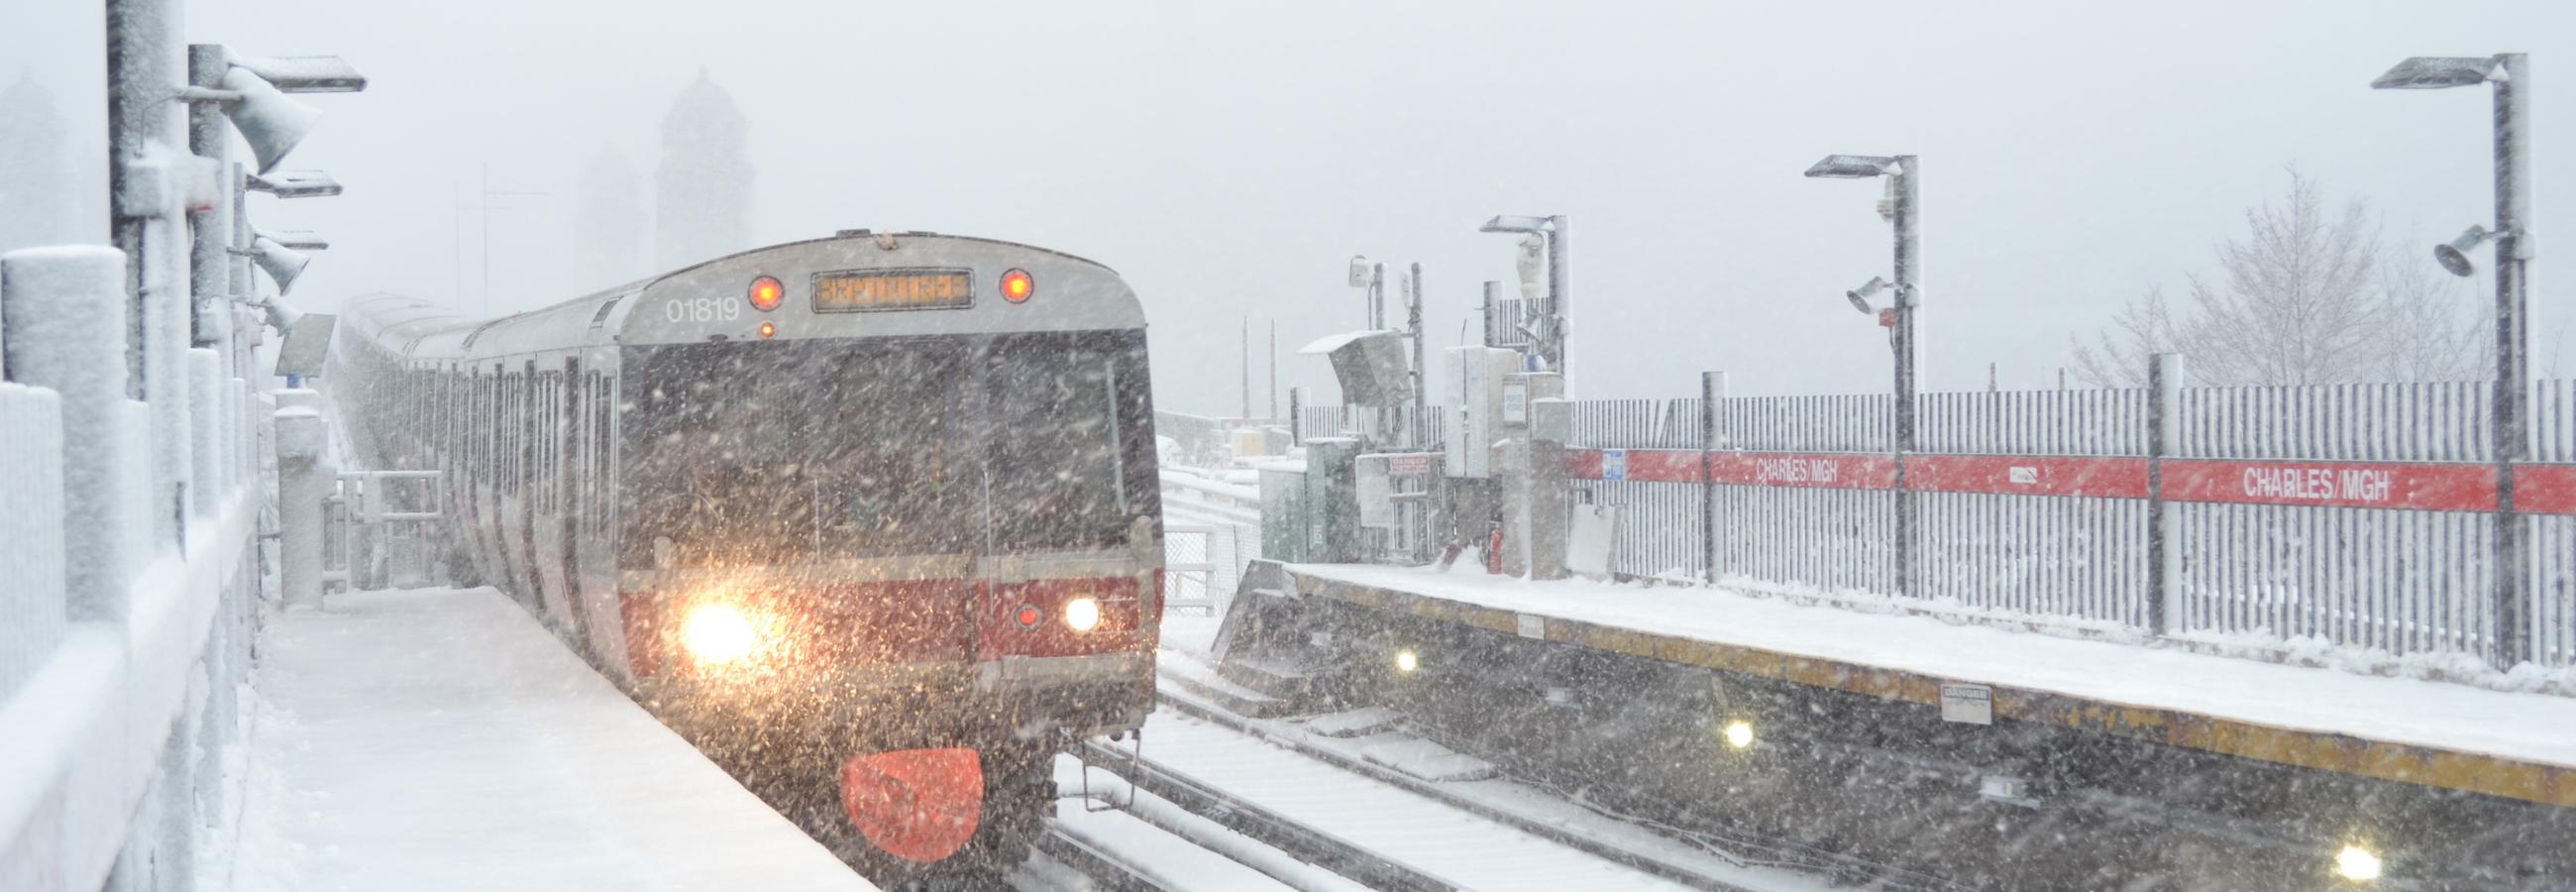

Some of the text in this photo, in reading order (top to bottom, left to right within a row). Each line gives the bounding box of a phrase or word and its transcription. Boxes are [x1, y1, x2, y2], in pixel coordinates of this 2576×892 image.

[666, 296, 740, 322] 01819
[1756, 458, 1839, 483] CHARLES/MGH
[2243, 467, 2390, 501] CHARLES/MGH
[1944, 687, 1987, 699] DANGER
